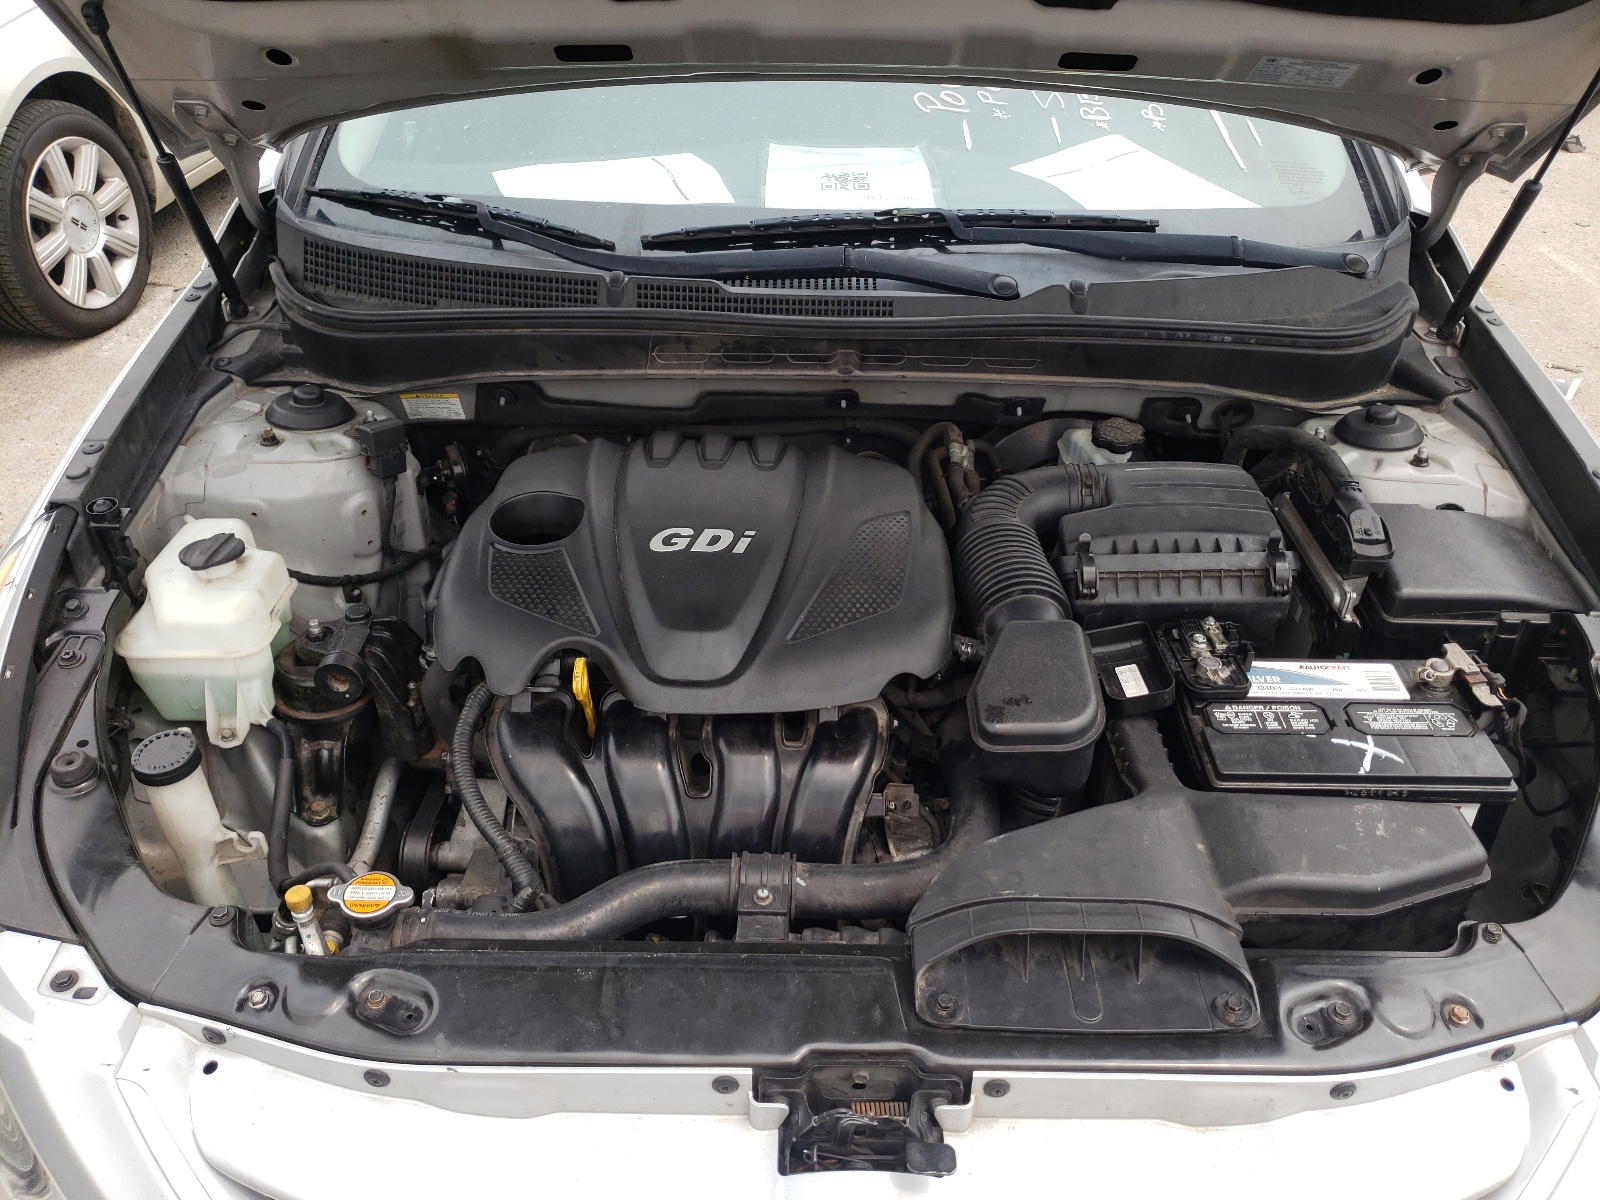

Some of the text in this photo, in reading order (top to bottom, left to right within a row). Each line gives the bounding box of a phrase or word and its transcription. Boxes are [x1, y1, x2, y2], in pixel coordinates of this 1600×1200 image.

[913, 85, 970, 113] Po
[649, 527, 757, 554] GDi
[1247, 675, 1281, 683] ILVER
